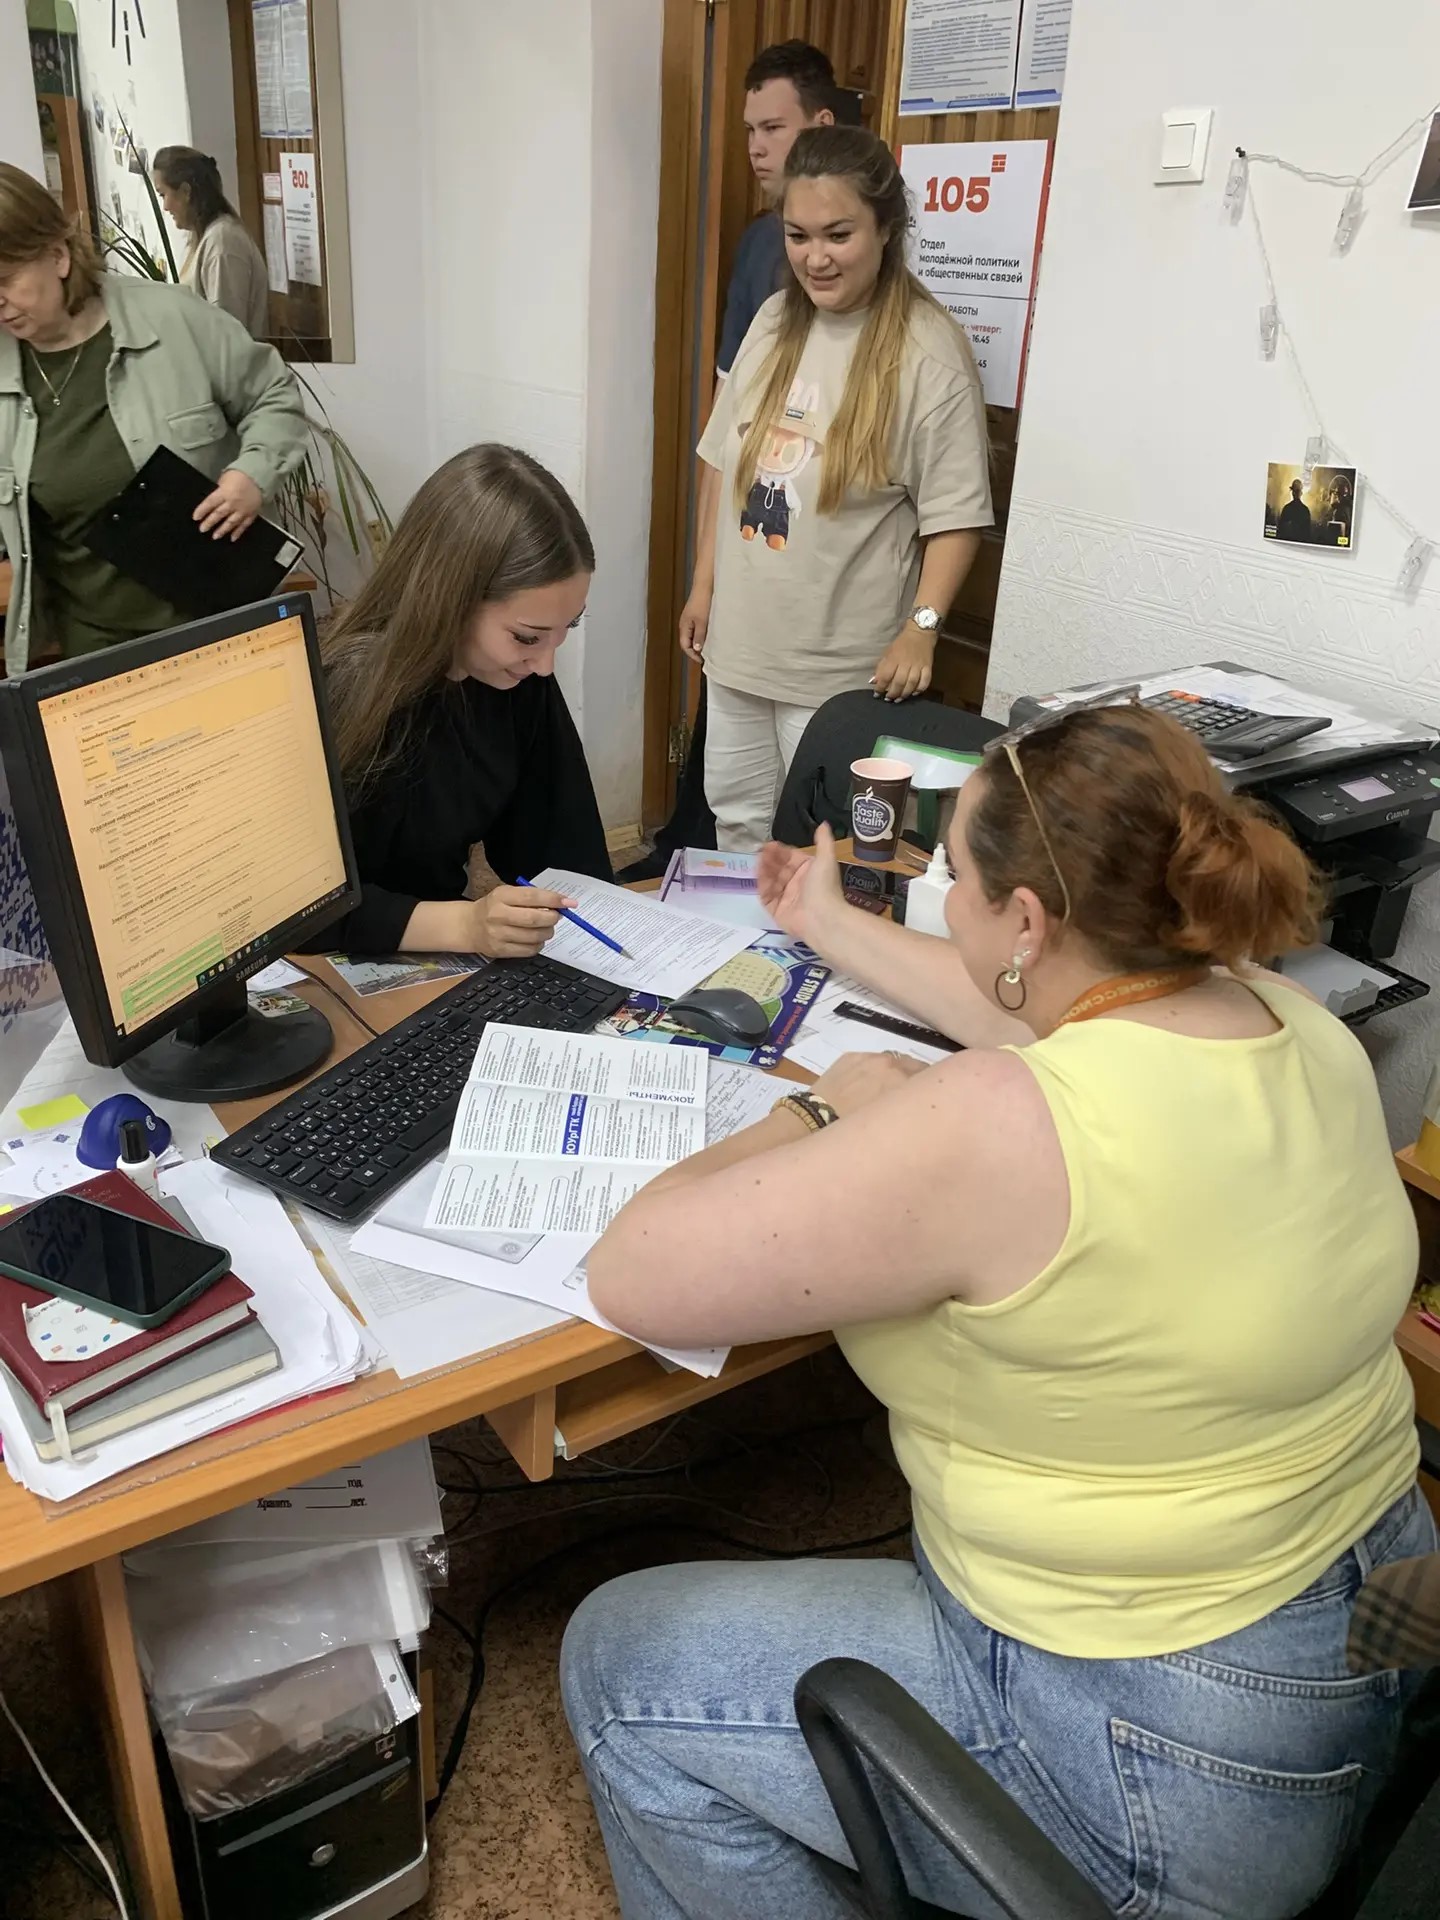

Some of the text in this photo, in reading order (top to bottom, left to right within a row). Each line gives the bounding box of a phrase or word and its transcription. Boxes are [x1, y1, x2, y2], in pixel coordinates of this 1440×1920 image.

[924, 176, 991, 213] 105
[920, 238, 946, 250] Отдел
[919, 253, 1020, 268] молодёжной политики
[925, 268, 989, 282] общественных
[990, 271, 1023, 283] связей
[948, 305, 979, 316] РАБОТЫ
[972, 334, 990, 344] 16.45
[856, 803, 884, 819] Taste
[854, 811, 888, 829] Quality
[236, 955, 268, 982] SAMSUNG
[565, 1116, 580, 1155] ЮУрГТК
[256, 1498, 292, 1511] Хранить
